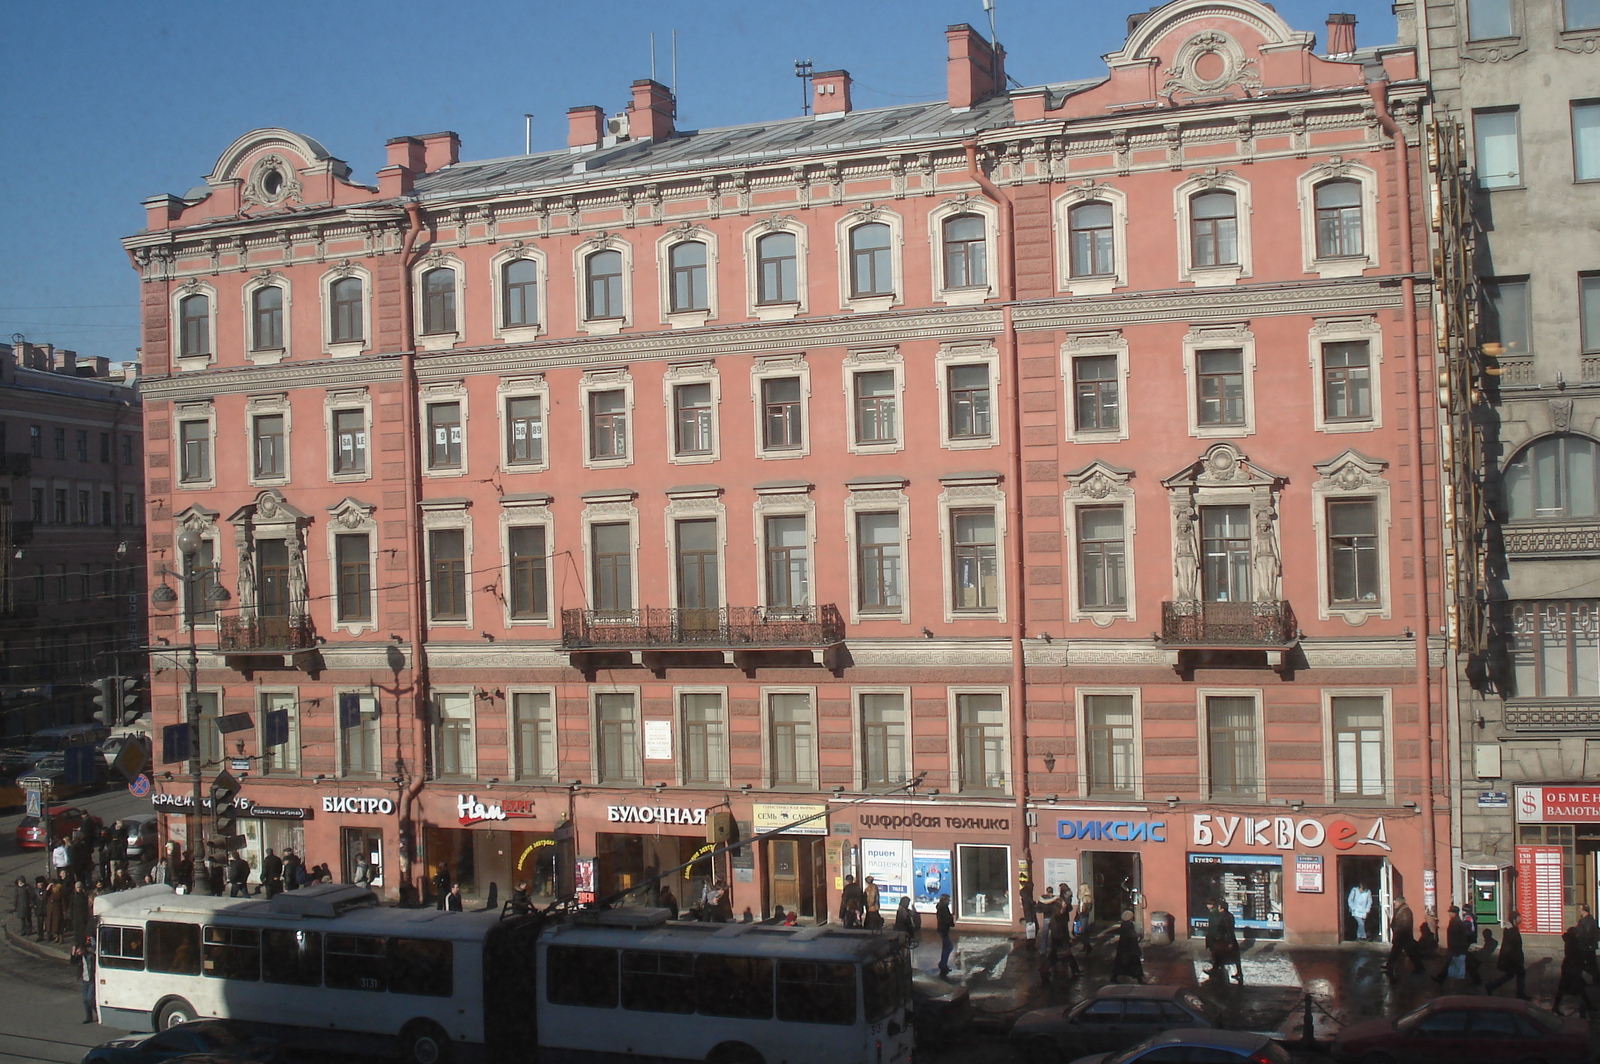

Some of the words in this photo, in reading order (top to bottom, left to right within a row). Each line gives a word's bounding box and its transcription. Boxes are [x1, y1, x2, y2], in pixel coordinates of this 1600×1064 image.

[451, 430, 461, 440] 74
[515, 427, 526, 436] 58
[532, 425, 542, 434] 89
[1546, 793, 1600, 803] ОБМЕН
[322, 796, 393, 814] БИСТРО
[457, 794, 507, 820] Ням
[501, 799, 535, 812] БУРГ
[607, 806, 706, 825] БУЛОЧНАЯ
[757, 812, 778, 820] СЕМЬ
[860, 812, 941, 830] цифровая
[944, 816, 1010, 831] техника
[868, 850, 895, 858] прием
[1266, 913, 1280, 922] 24
